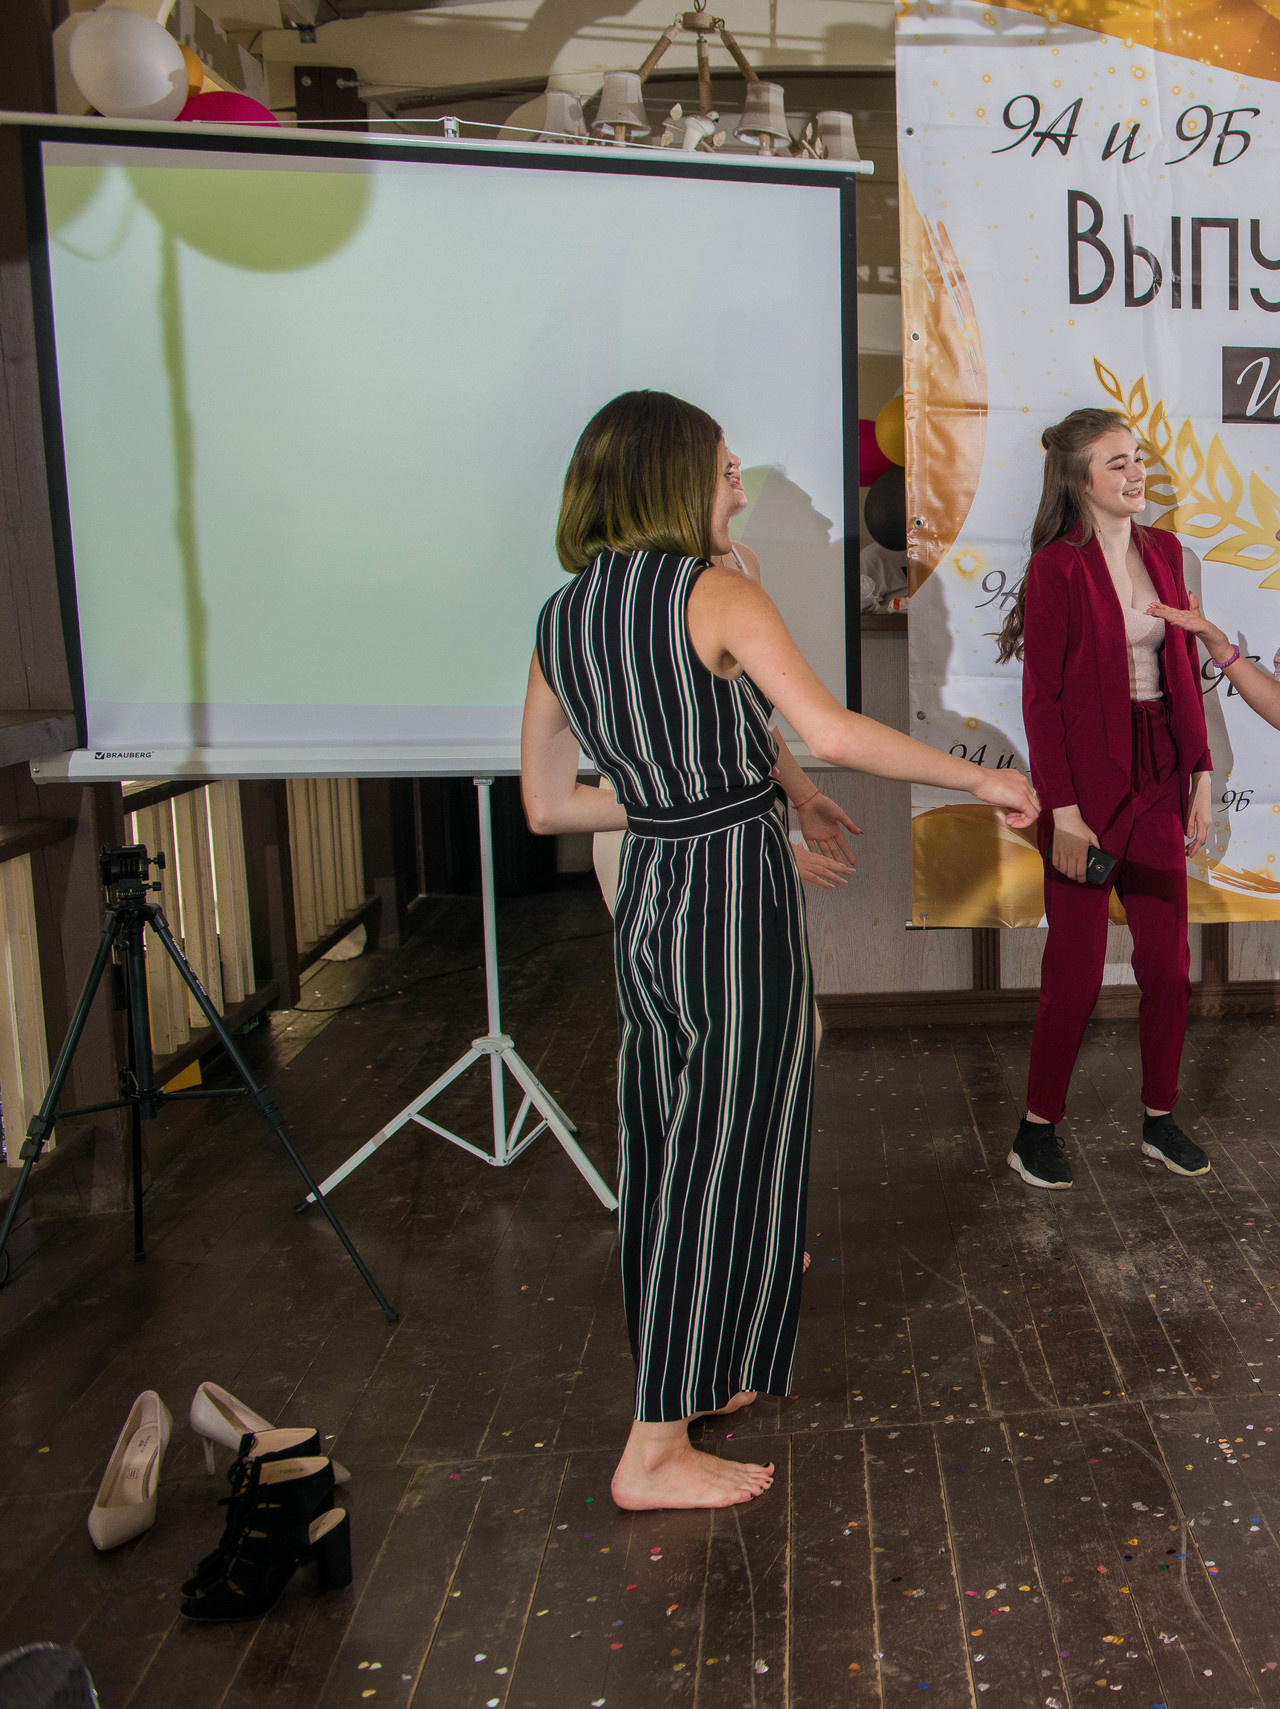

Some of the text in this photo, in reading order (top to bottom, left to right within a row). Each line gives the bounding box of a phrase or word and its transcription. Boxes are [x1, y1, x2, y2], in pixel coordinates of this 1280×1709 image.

[991, 94, 1261, 167] 9А и 9Б
[105, 751, 152, 759] BRAUBERG
[1217, 789, 1255, 813] 9Б
